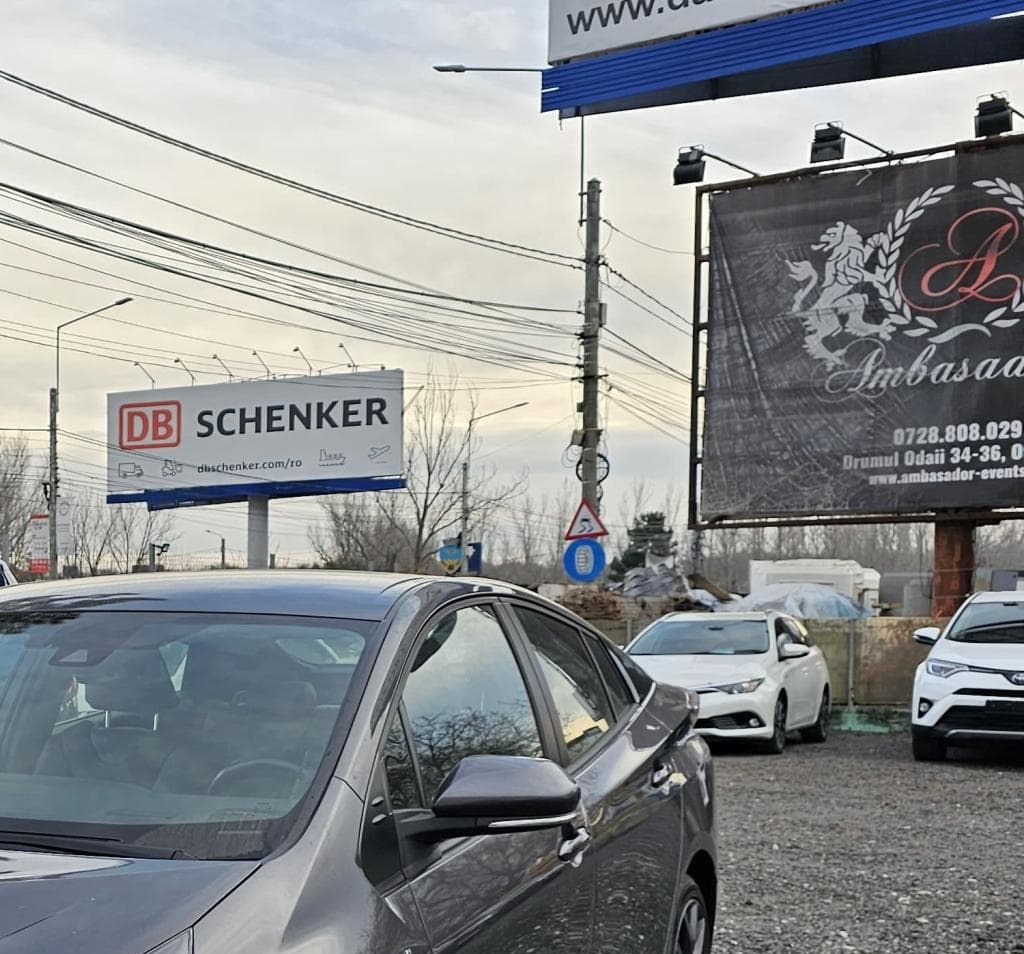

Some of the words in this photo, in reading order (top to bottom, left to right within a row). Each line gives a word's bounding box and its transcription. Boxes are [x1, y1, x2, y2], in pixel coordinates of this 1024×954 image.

[566, 0, 713, 35] www.
[126, 408, 174, 442] DB
[196, 397, 389, 438] SCHENKER
[893, 420, 1023, 445] 0728.808.029
[197, 458, 302, 473] dbschenker.com/ro
[843, 451, 899, 469] Drumul
[904, 448, 945, 466] Odaii
[950, 444, 1006, 464] 34-36,
